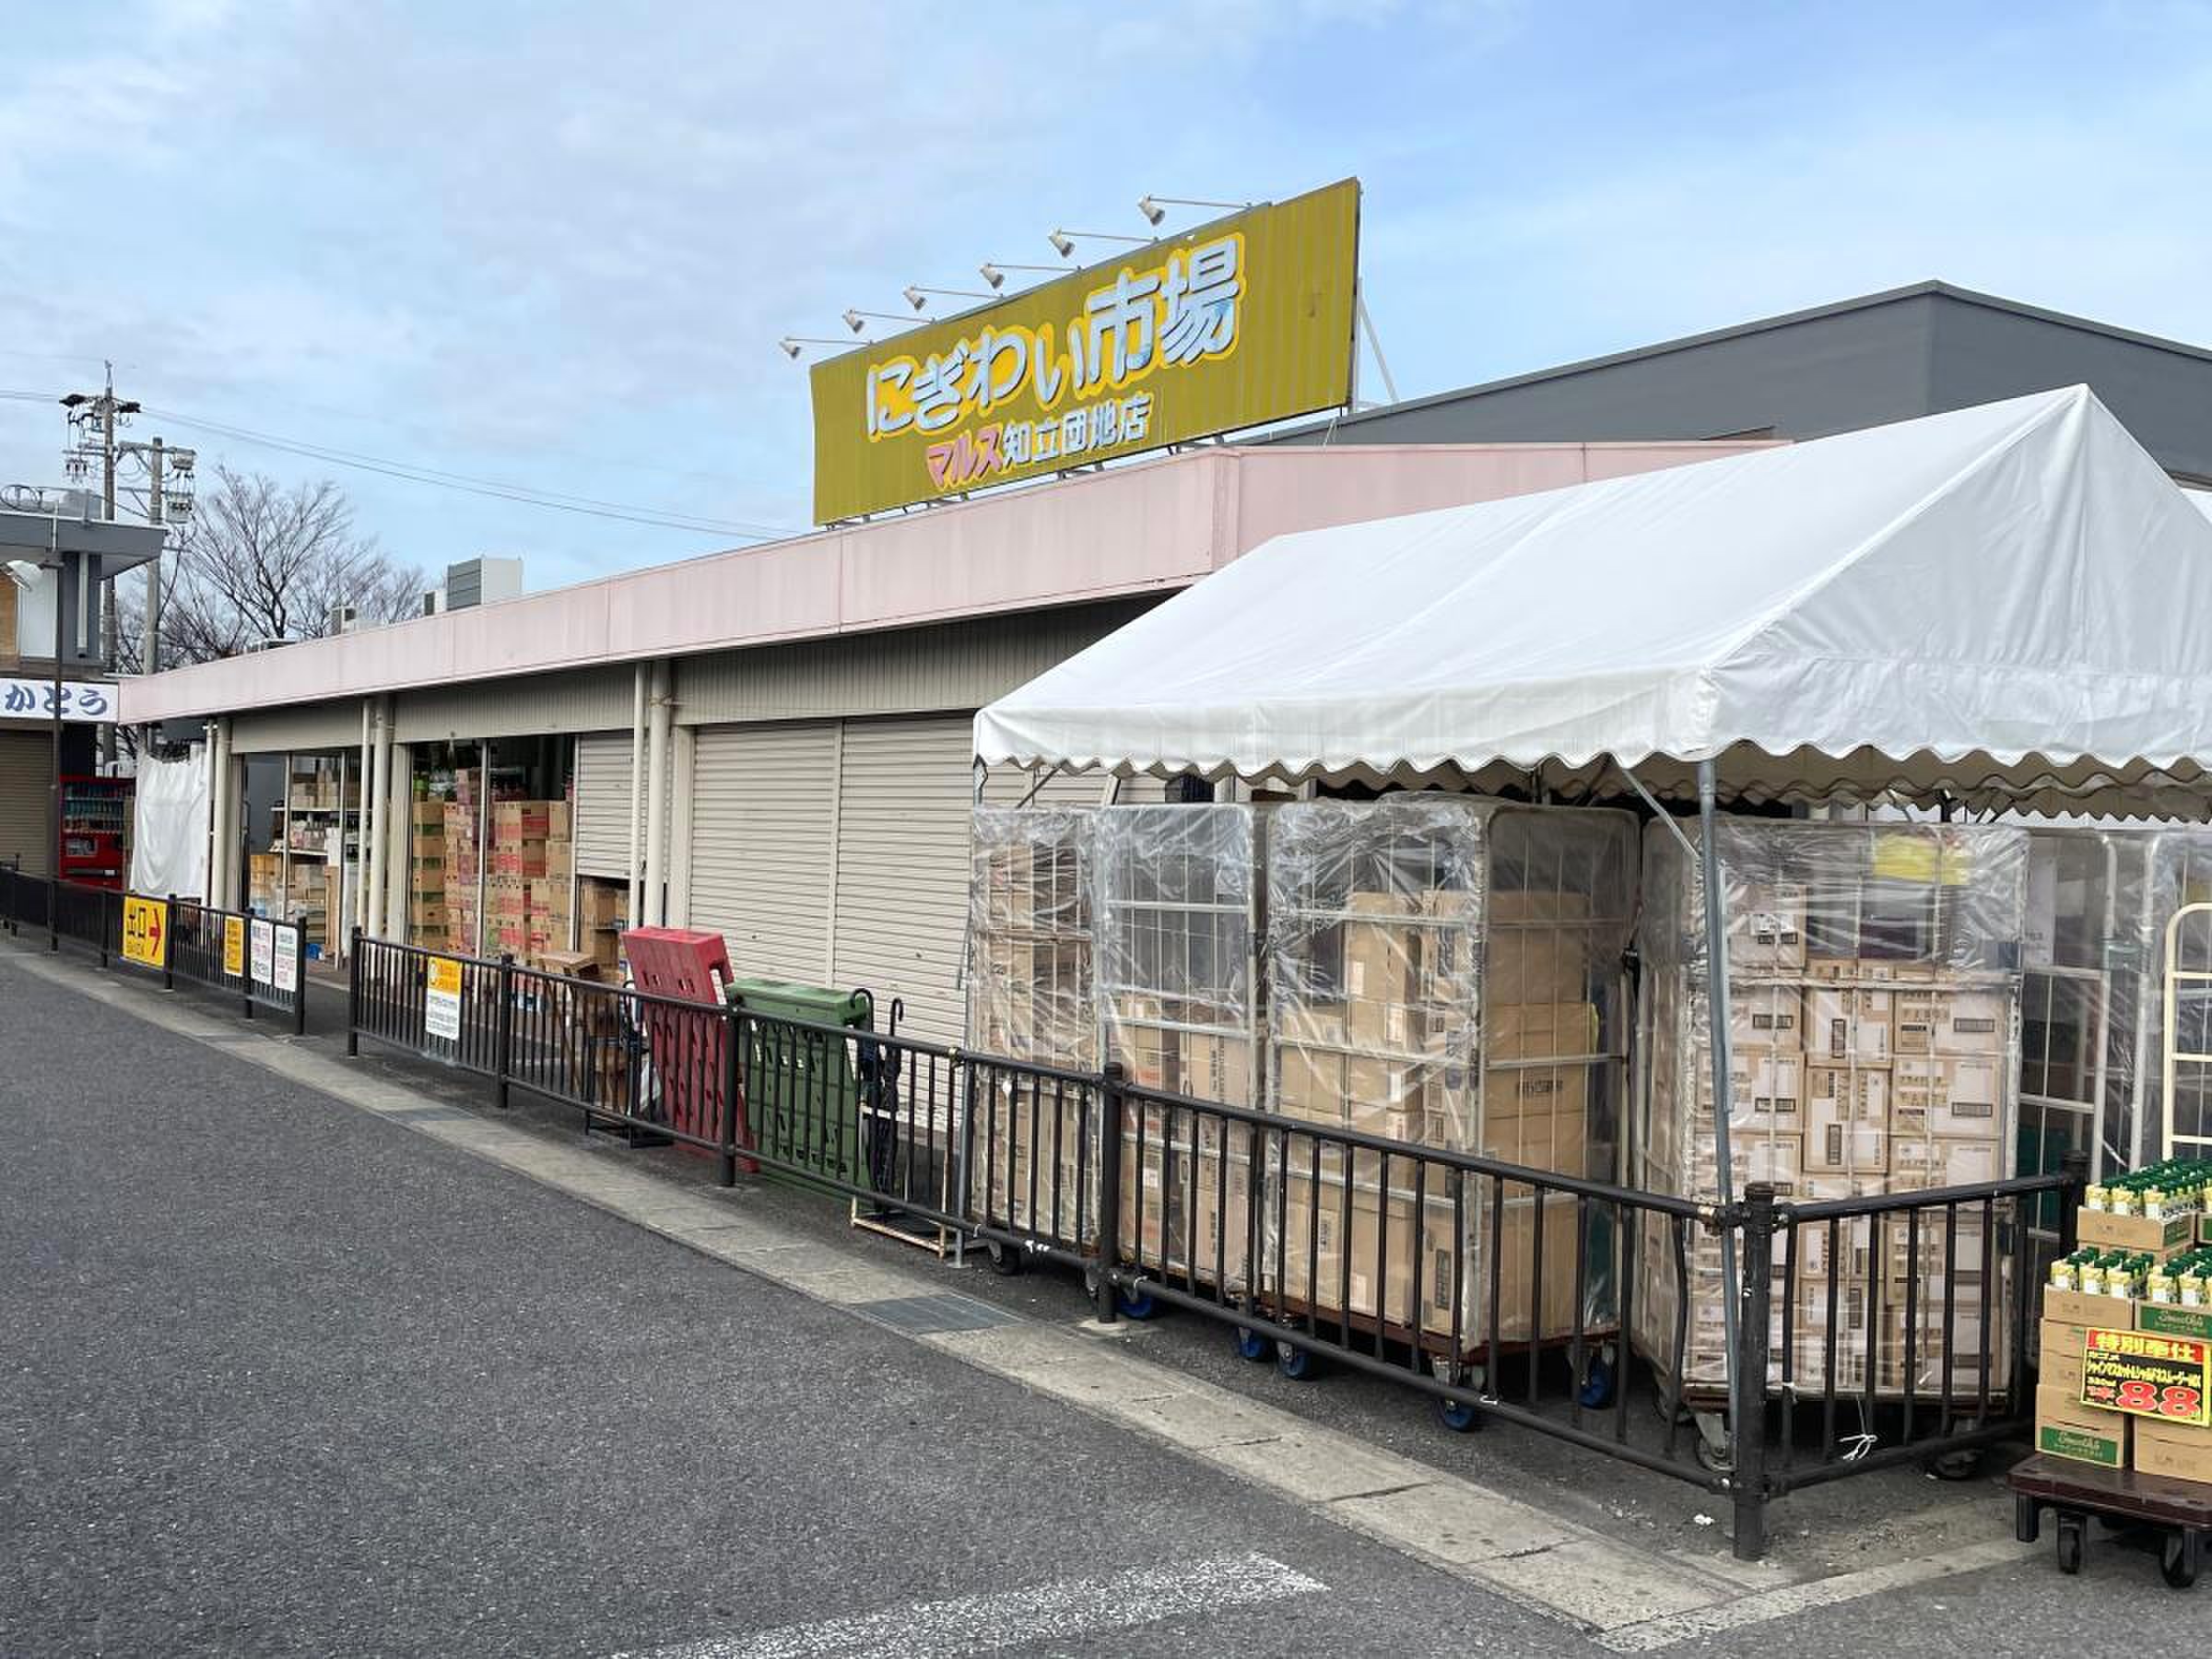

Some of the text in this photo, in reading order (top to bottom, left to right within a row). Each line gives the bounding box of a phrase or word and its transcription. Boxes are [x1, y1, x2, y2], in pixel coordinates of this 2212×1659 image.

[865, 238, 1241, 436] にぎわい市場
[927, 395, 1150, 486] マルス知立団地店
[5, 684, 108, 715] かとう
[2096, 1332, 2194, 1362] 特別奉仕
[2115, 1380, 2201, 1418] 88
